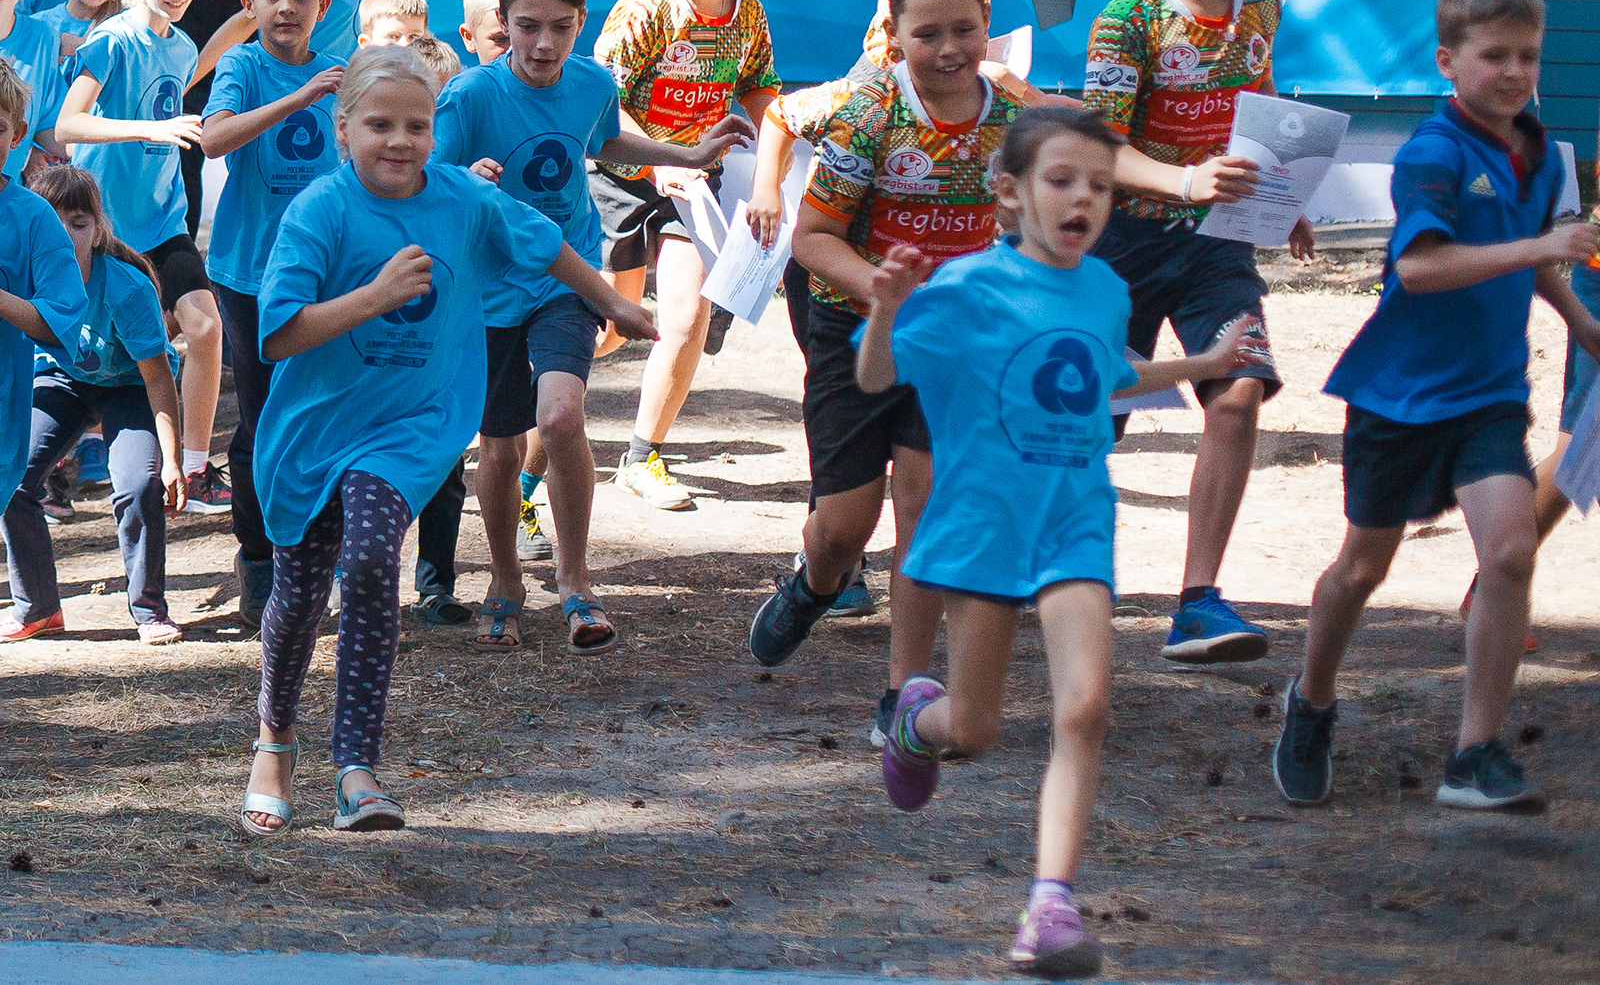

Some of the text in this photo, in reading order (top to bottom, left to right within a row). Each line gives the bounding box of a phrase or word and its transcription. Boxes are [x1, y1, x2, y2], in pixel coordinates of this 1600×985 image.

[659, 64, 699, 73] regbist.ru
[1157, 73, 1206, 83] regbist.ru
[878, 178, 936, 191] regbist.ru
